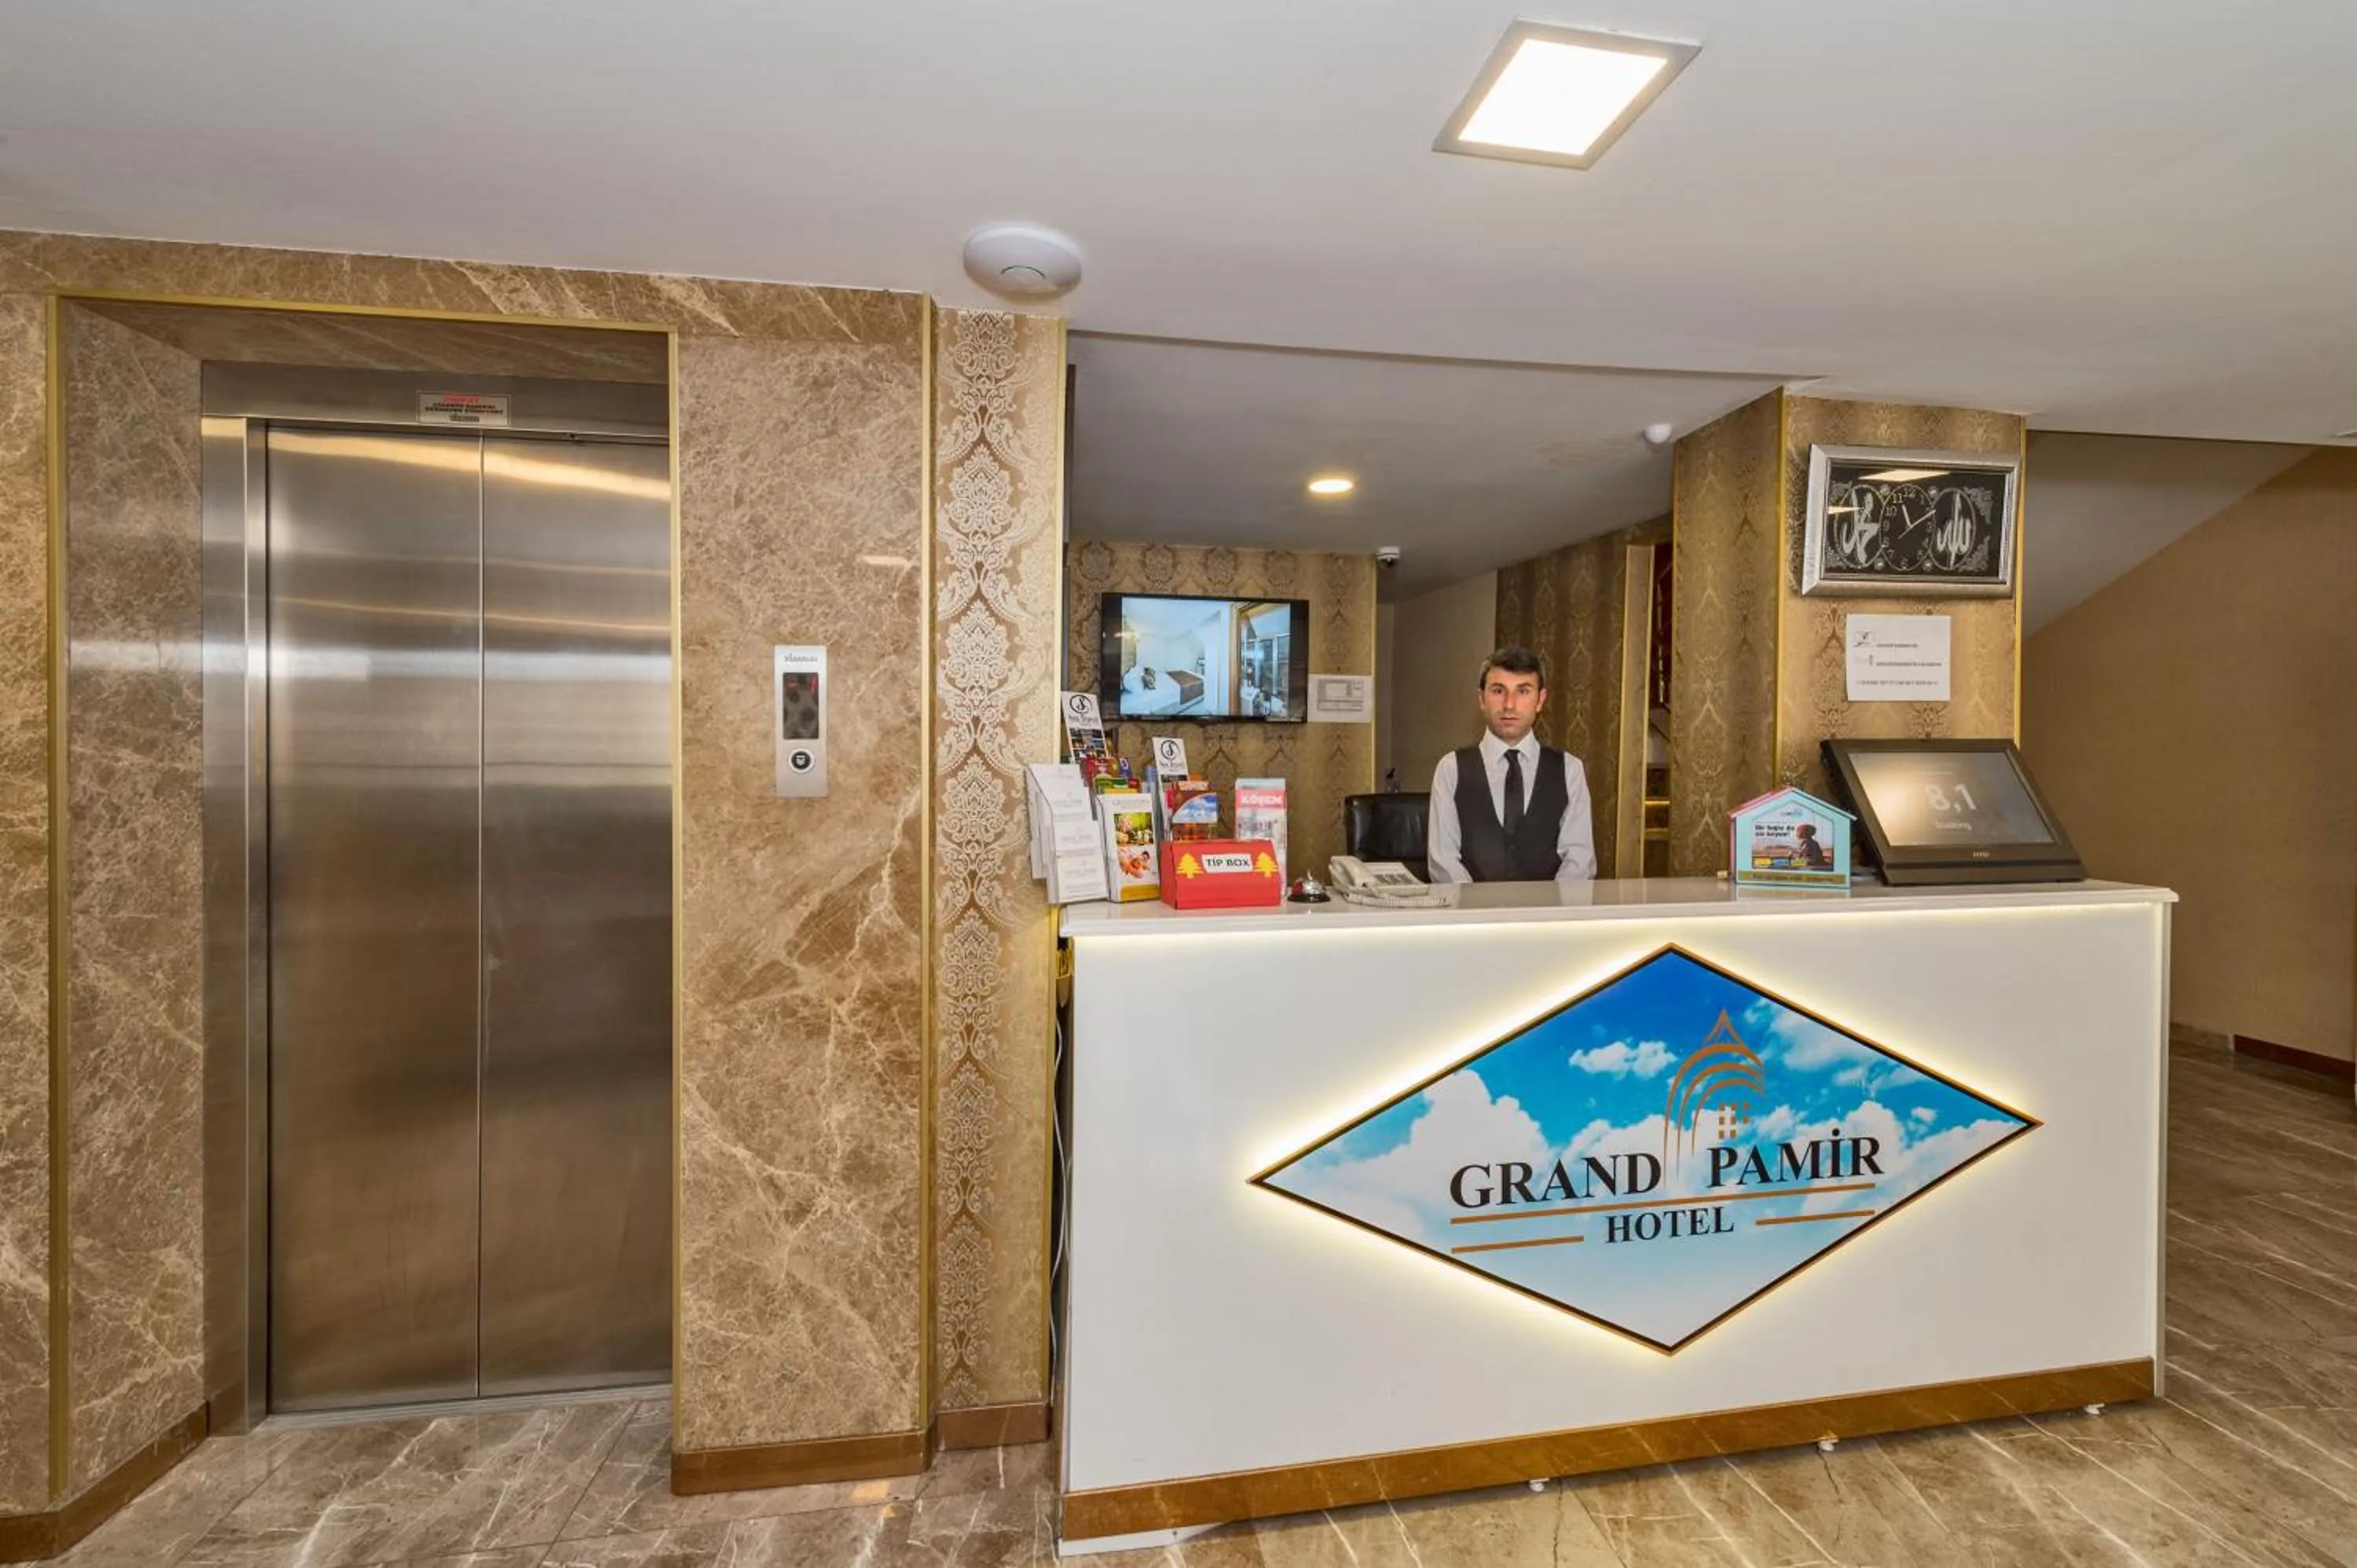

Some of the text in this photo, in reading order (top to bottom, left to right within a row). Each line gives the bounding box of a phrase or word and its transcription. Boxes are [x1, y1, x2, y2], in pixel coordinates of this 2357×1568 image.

[1226, 858, 1250, 867] BOX
[1450, 1128, 1885, 1209] GRAND PAMİR
[1605, 1206, 1735, 1244] HOTEL
